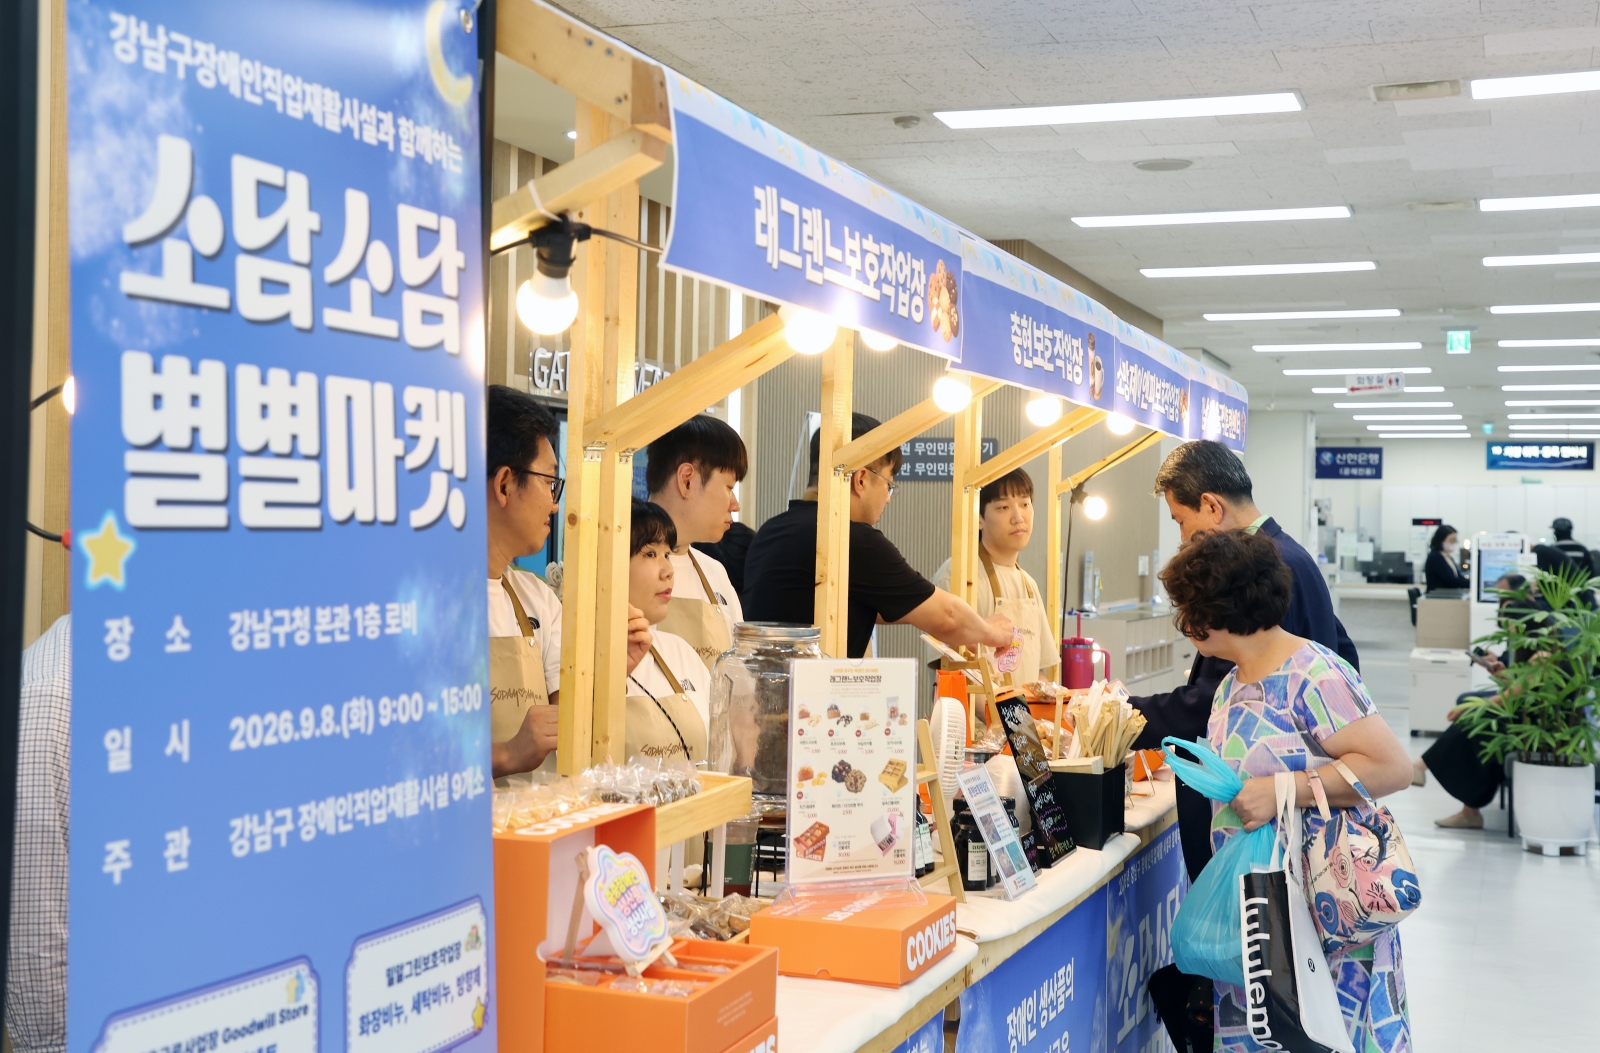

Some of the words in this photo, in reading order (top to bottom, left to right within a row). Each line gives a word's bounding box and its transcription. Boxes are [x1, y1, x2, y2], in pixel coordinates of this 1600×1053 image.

[109, 11, 396, 151] 강남구장애인직업재활시설과
[398, 117, 464, 174] 함께하는
[120, 134, 466, 355] 소담소담
[753, 184, 927, 324] 래그랜느보호작업장
[1010, 310, 1084, 387] 충현보호작업장
[120, 350, 468, 529] 별별마켓
[1335, 452, 1380, 465] 신한은행
[228, 608, 312, 651] 강남구청
[314, 605, 351, 644] 본관
[353, 604, 383, 640] 1층
[384, 600, 418, 635] 로비
[229, 696, 375, 751] 2026.9.8.(화)
[379, 692, 424, 727] 9:00
[440, 683, 483, 717] 15:00
[229, 806, 295, 857] 강남구
[297, 773, 449, 842] 장애인직업재활시설
[451, 767, 485, 801] 9개소
[906, 909, 956, 972] COOKIES
[221, 1012, 277, 1044] Goodwill
[279, 1004, 309, 1026] Store
[1006, 988, 1037, 1053] 장애인
[1039, 956, 1074, 1030] 생산품의
